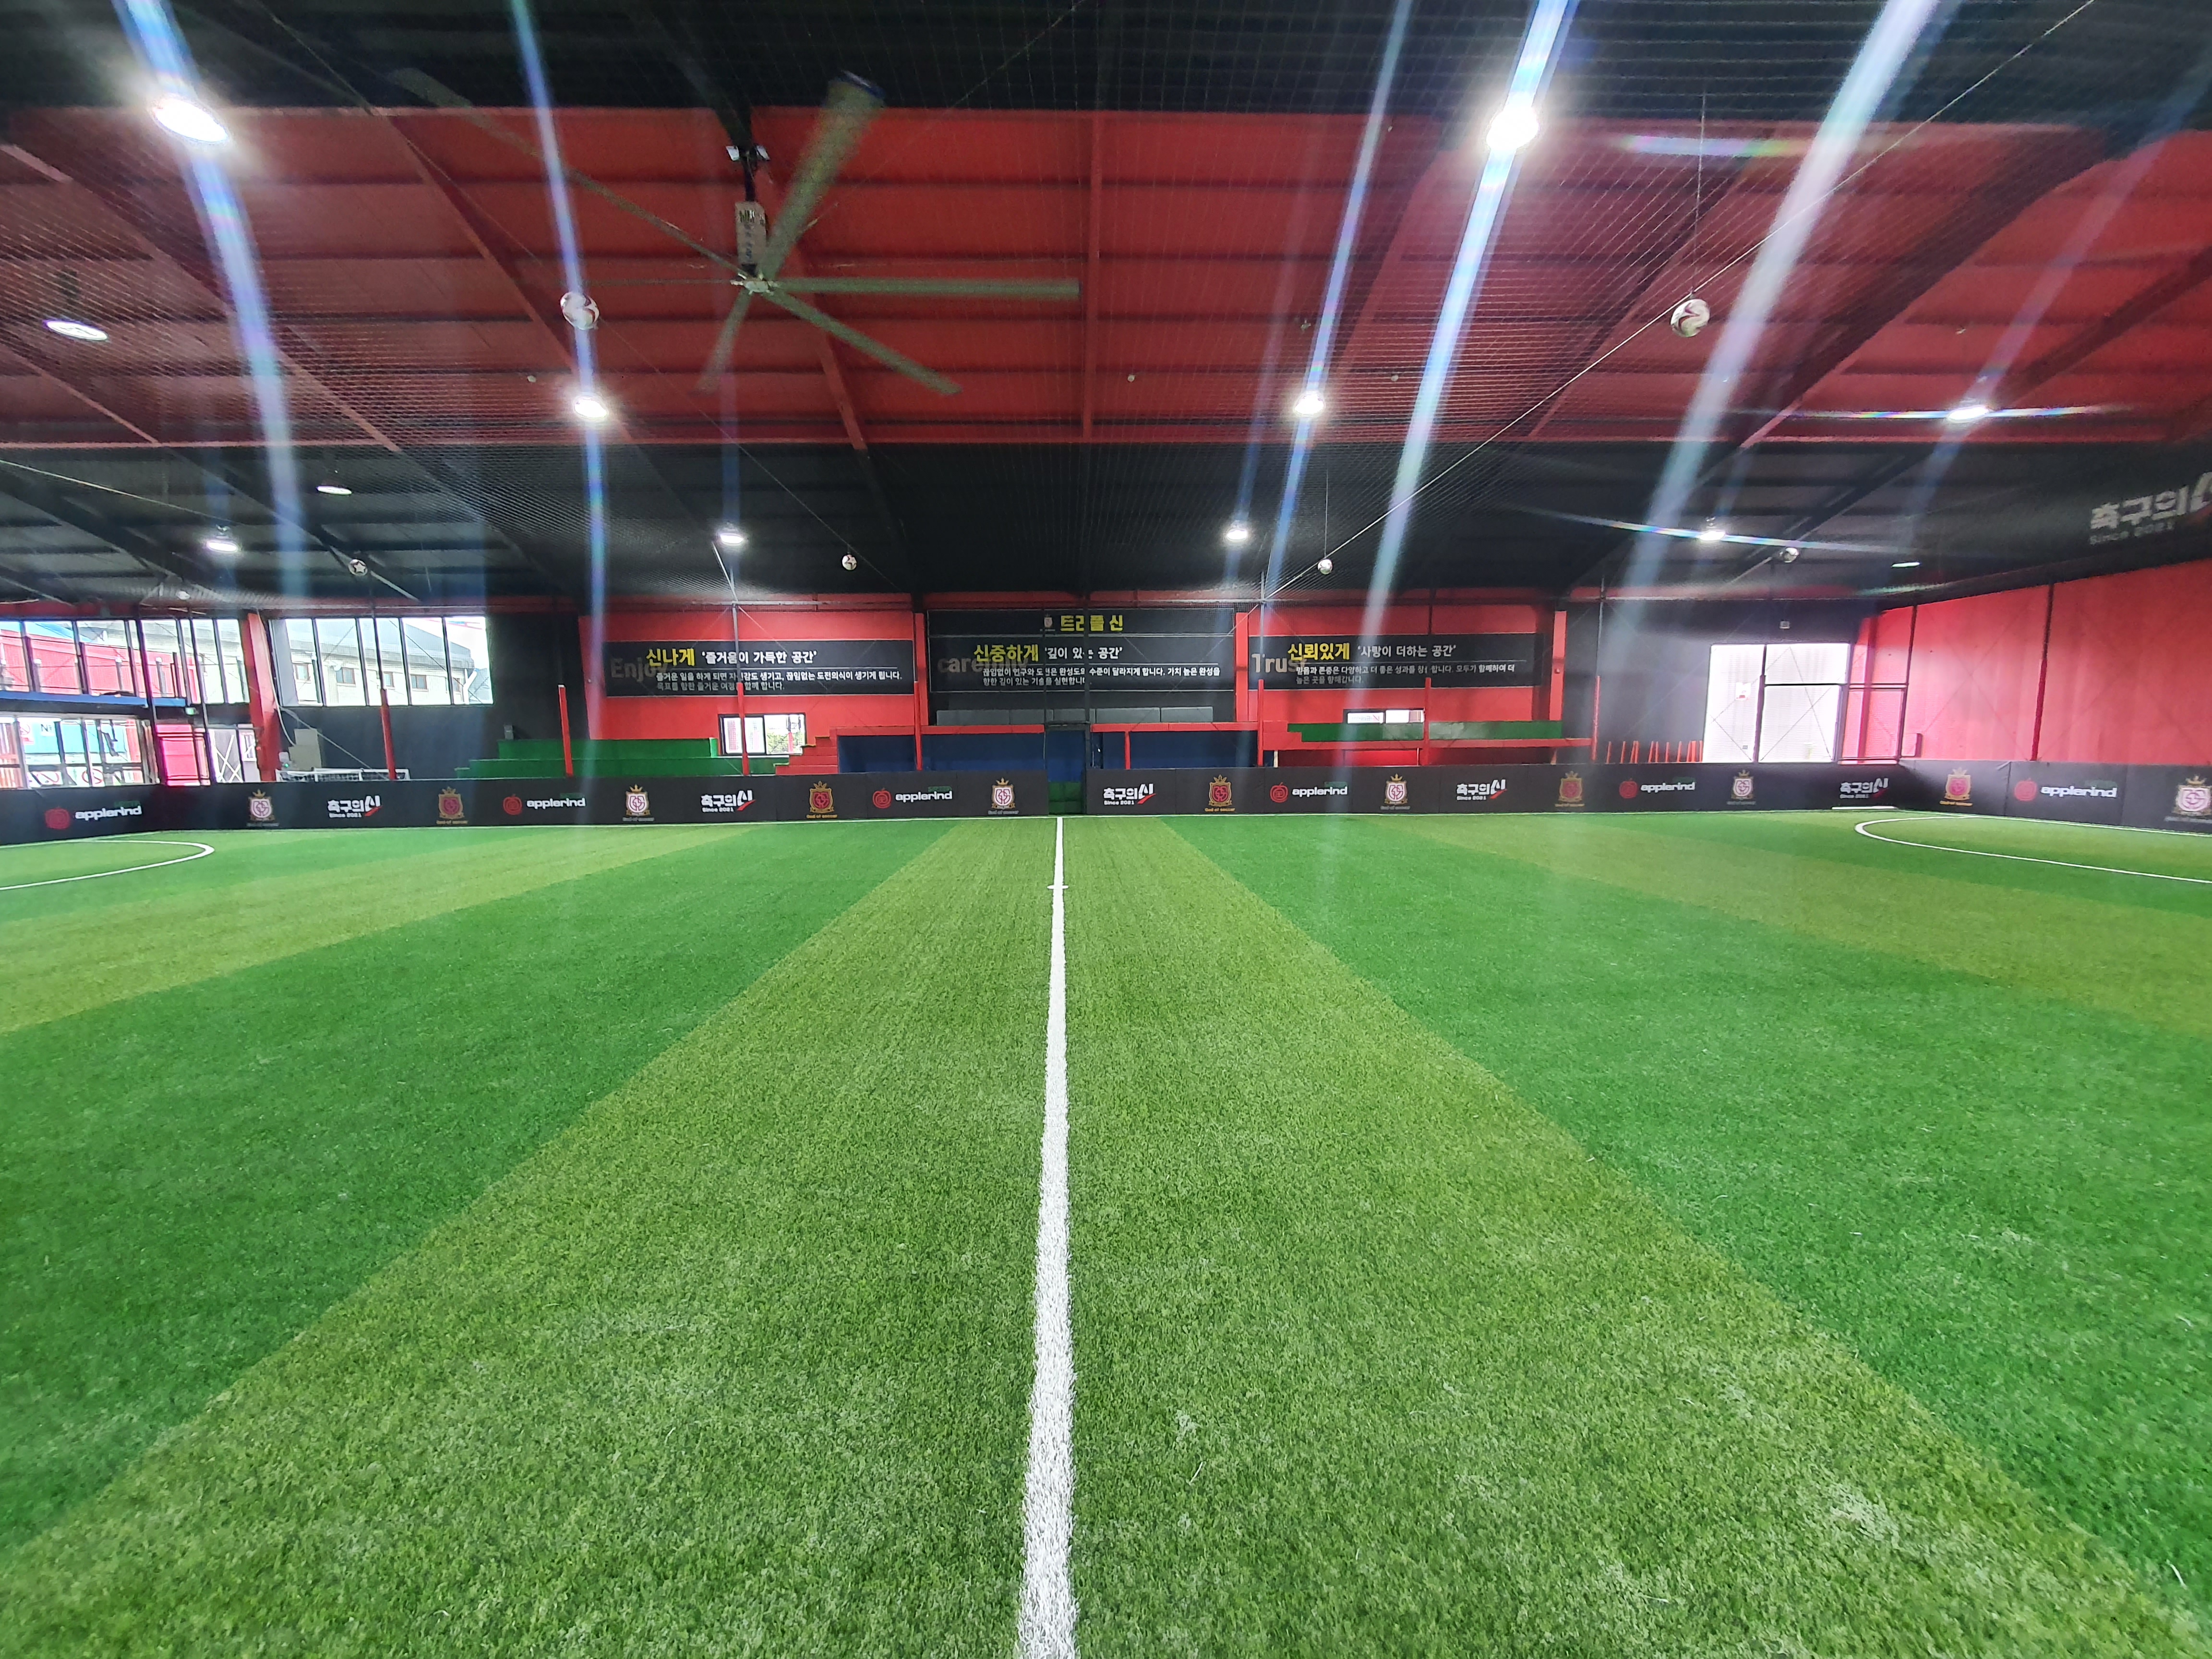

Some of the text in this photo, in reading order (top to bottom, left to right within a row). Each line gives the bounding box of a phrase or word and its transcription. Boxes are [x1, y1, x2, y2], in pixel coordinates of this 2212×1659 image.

[1109, 614, 1123, 631] 신
[646, 648, 695, 667] 신나게
[753, 651, 787, 664] 가득한
[974, 644, 1039, 662] 신중하게
[1287, 643, 1350, 661] 신뢰있게
[1396, 645, 1428, 658] 더하는
[1112, 667, 1140, 676] 달라지게
[1167, 667, 1181, 676] 가치
[1370, 665, 1377, 674] 더
[1507, 664, 1515, 672] 더
[696, 672, 710, 681] 하게
[999, 677, 1013, 686] 깊이
[1015, 677, 1030, 686] 있는
[721, 682, 742, 691] 여정
[895, 791, 952, 803] applerind
[1292, 786, 1348, 797] applerind
